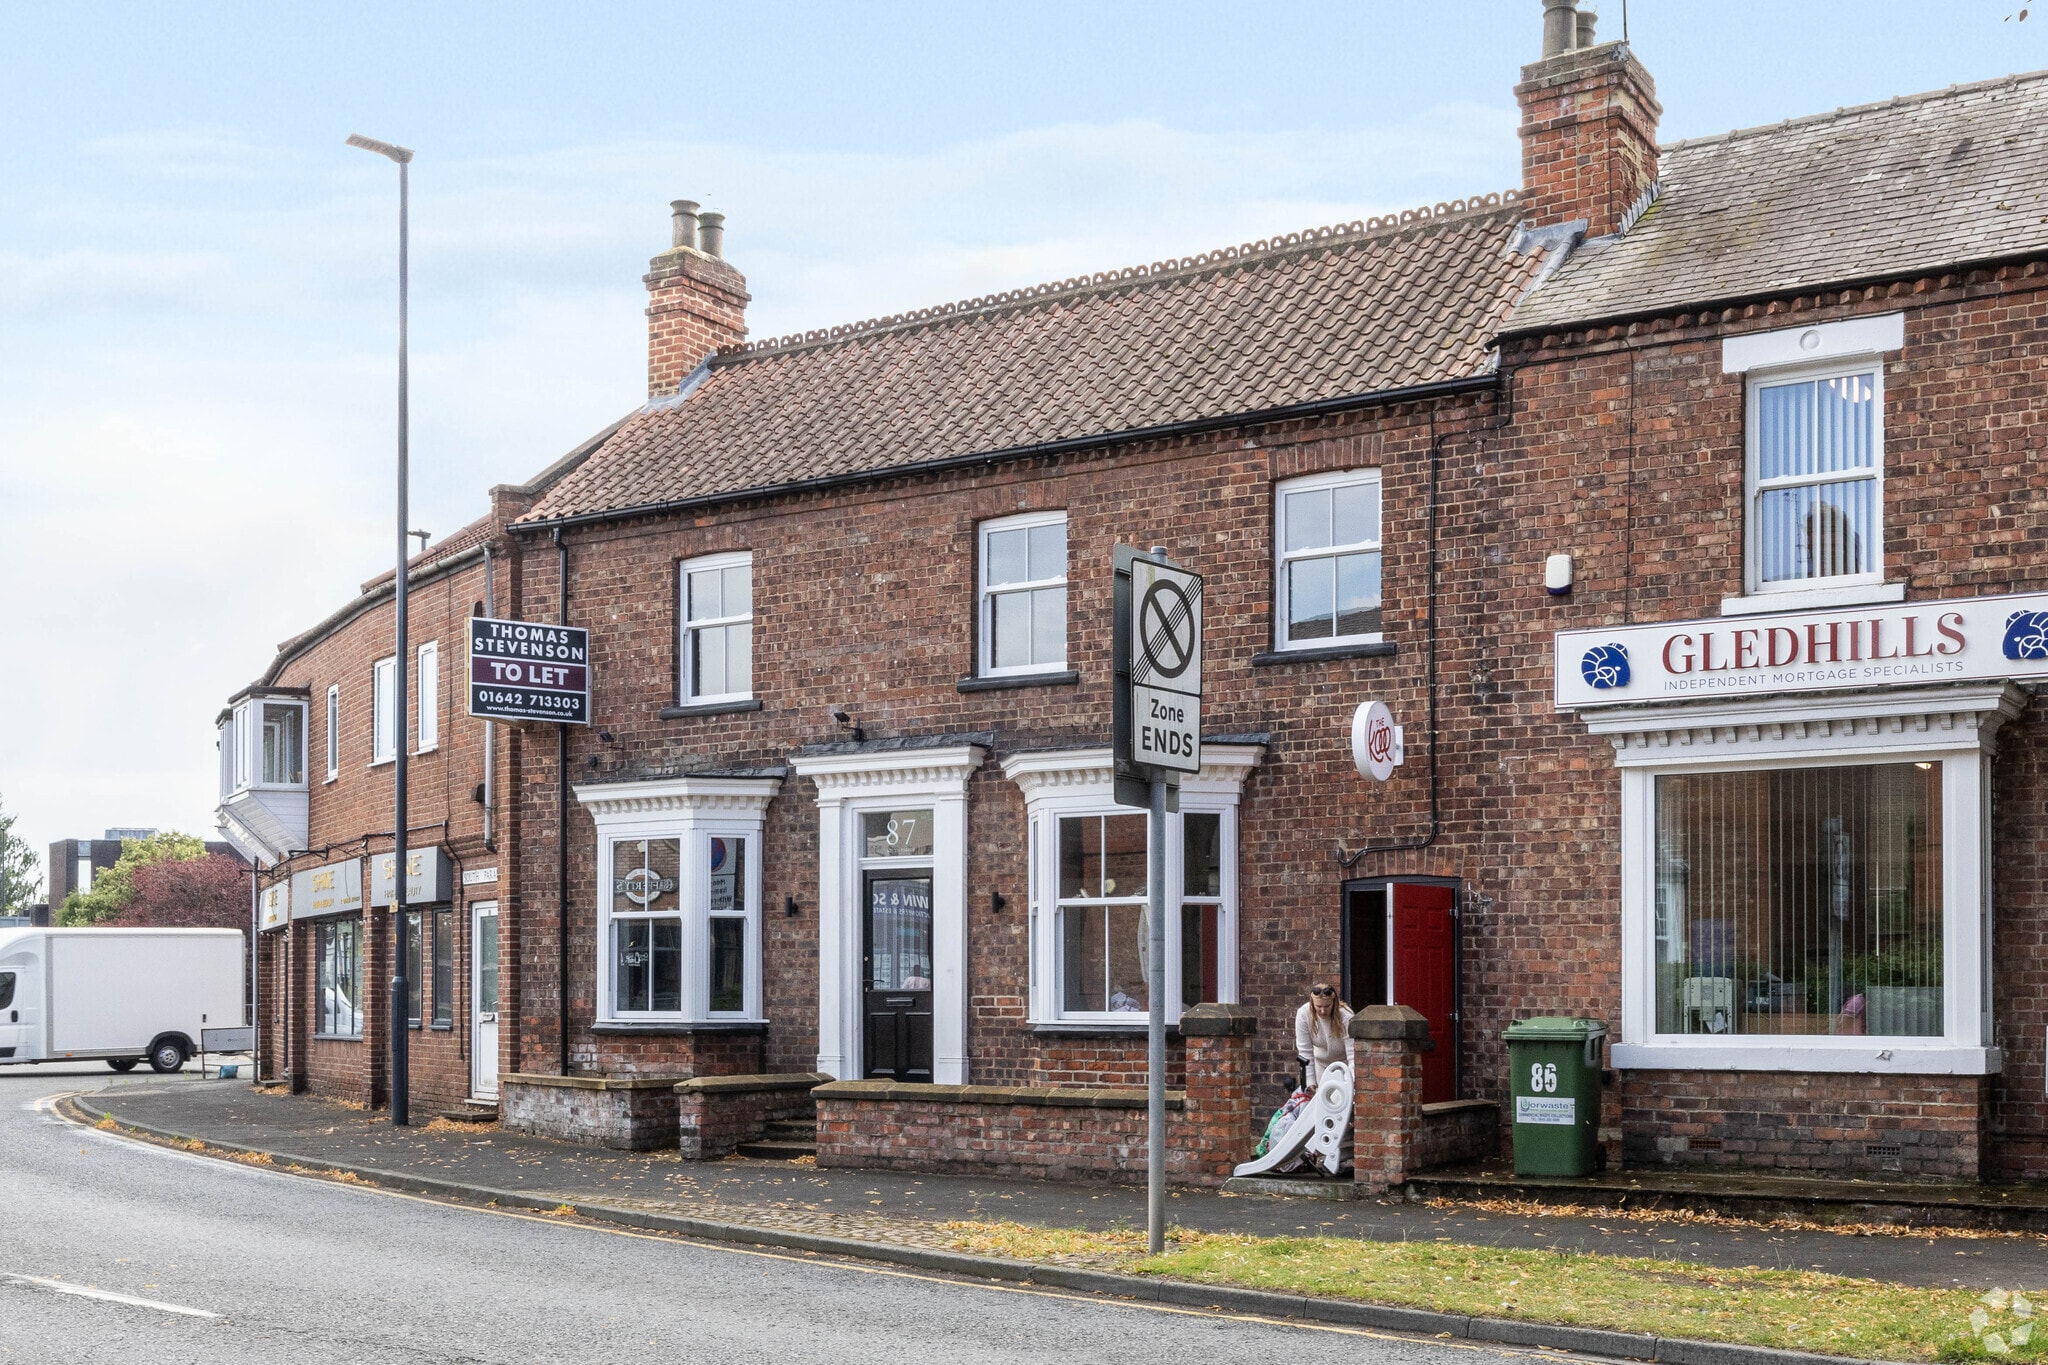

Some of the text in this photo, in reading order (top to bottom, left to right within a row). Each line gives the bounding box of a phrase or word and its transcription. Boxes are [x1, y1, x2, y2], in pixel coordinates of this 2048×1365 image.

[490, 624, 569, 644] THOMAS
[1662, 611, 1966, 674] GLEDHILLS
[474, 637, 583, 660] STEVENSON
[490, 662, 569, 685] TO LET
[1664, 661, 1964, 691] INDEPENDENT MORTGAGE SPECIALISTS
[479, 690, 580, 709] 01642 713303
[486, 705, 573, 717] www.thomas-stevenson.co.uk
[1151, 698, 1184, 723] Zone
[1375, 717, 1385, 728] THE
[1142, 725, 1193, 758] ENDS
[886, 819, 916, 845] 87
[382, 854, 422, 880] SHNE
[1531, 1062, 1557, 1093] 86
